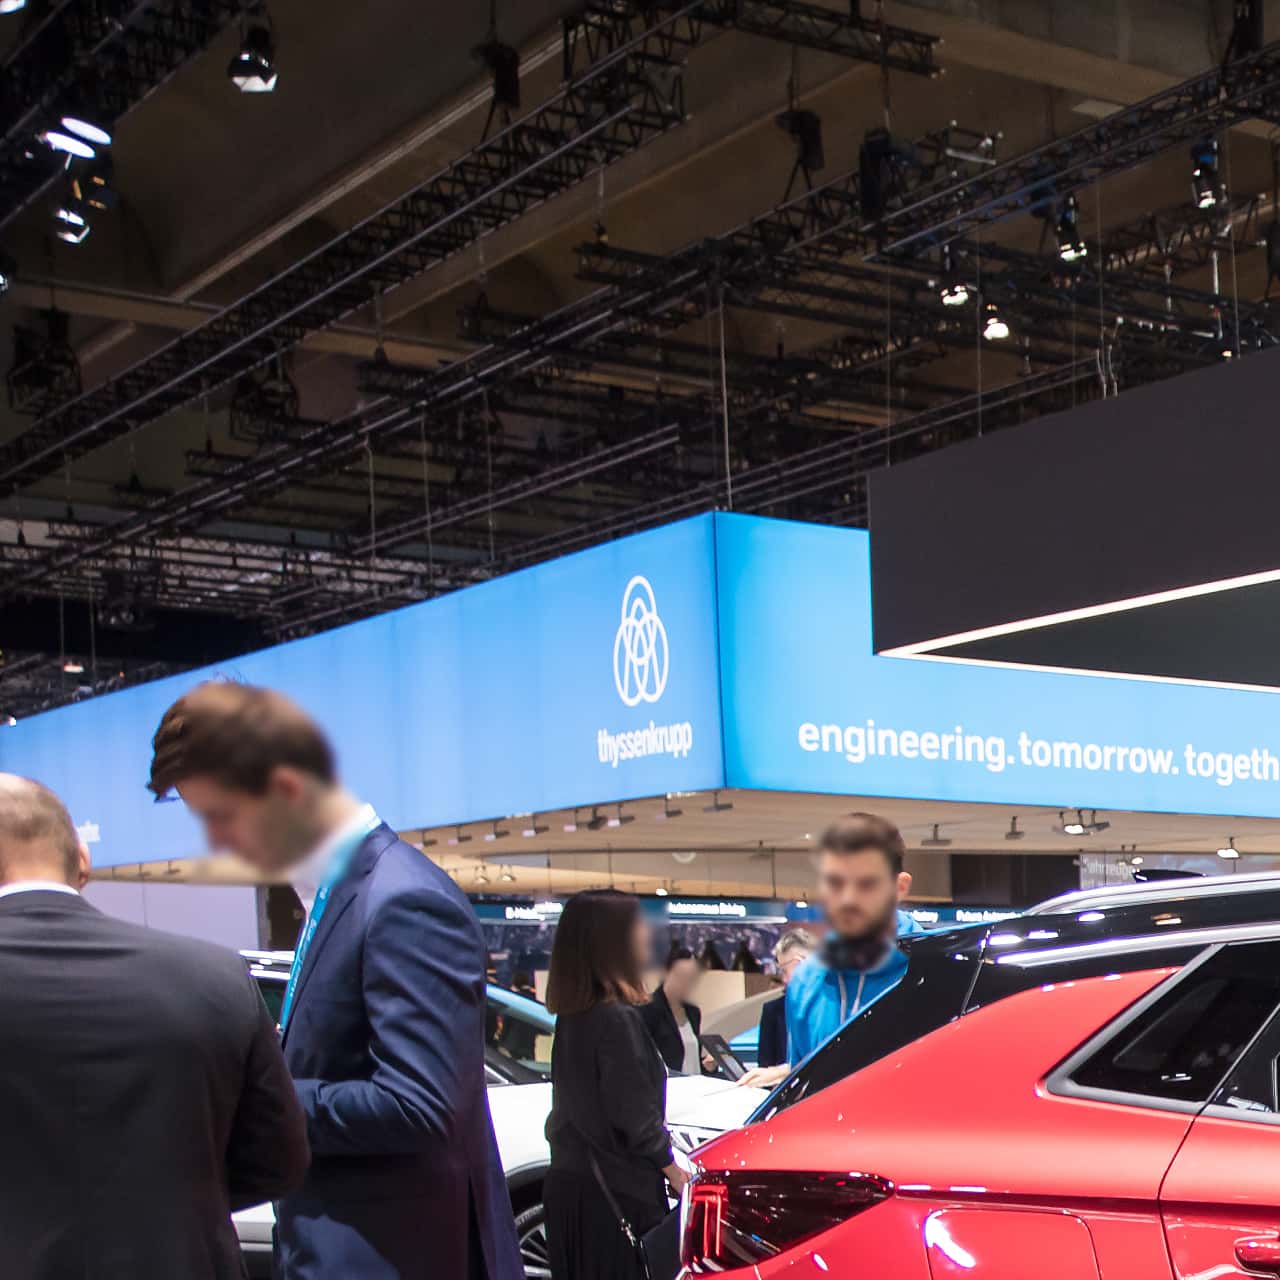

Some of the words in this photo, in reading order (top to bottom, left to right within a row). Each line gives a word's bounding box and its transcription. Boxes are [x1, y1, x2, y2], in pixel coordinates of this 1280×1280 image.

[597, 719, 692, 768] thyssenkrupp
[798, 719, 1015, 772] engineering.
[1018, 731, 1179, 776] tomorrow.
